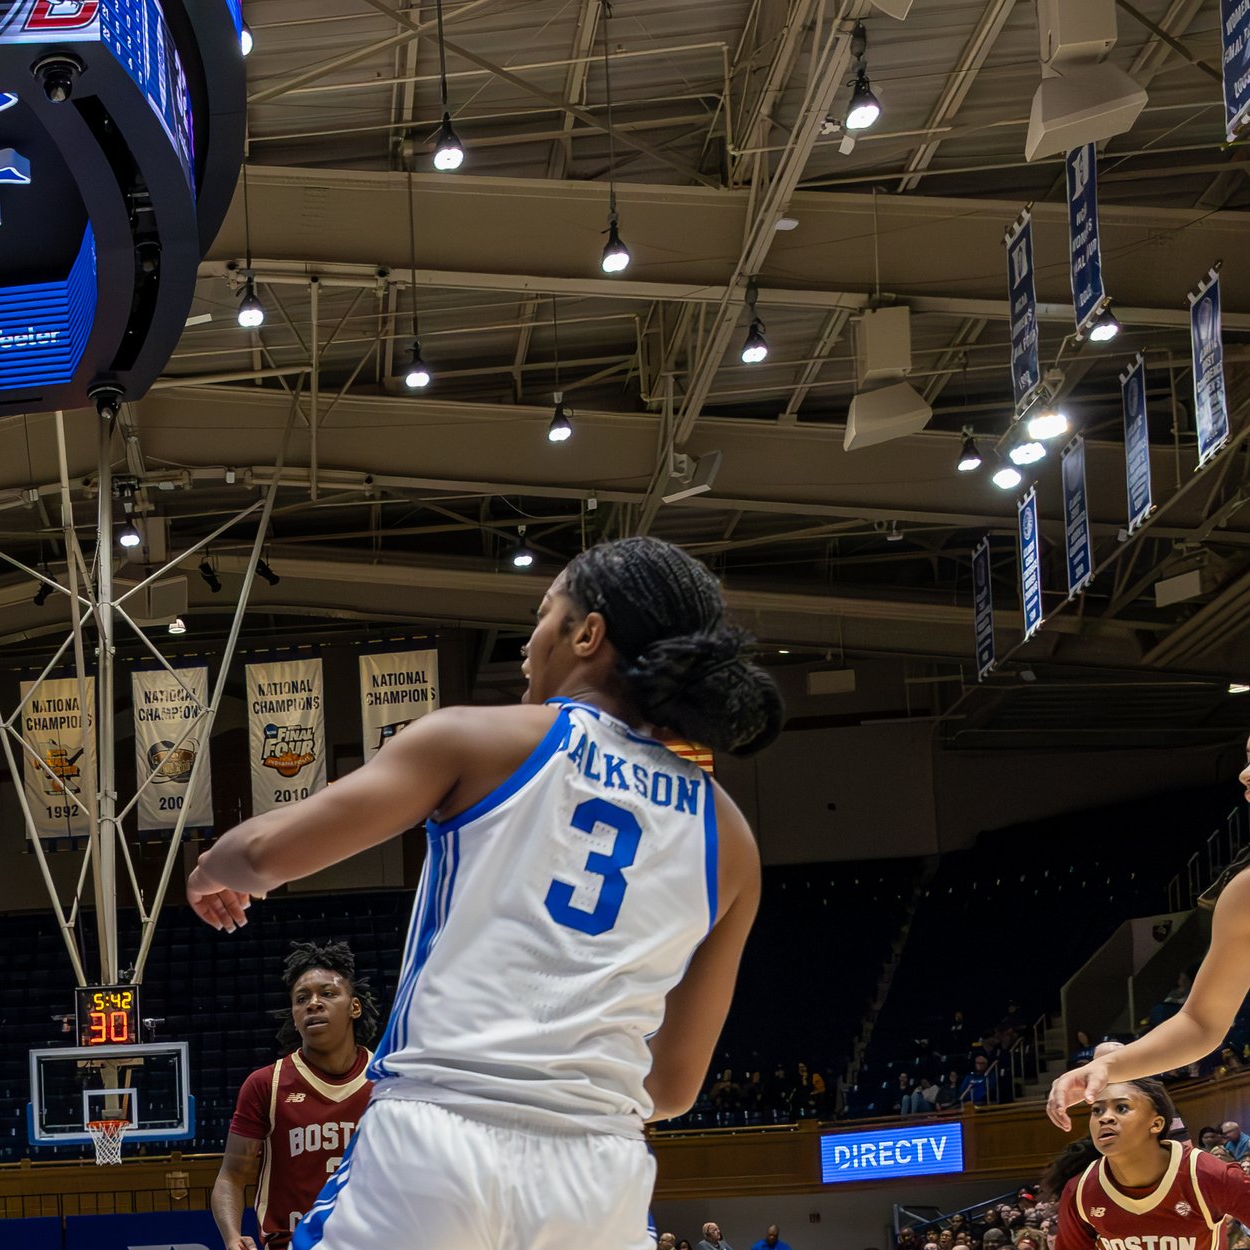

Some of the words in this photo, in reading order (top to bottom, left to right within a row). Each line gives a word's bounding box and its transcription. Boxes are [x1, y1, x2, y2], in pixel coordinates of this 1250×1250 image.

[258, 679, 312, 697] NATIONAL
[372, 671, 428, 688] NATIONAL
[366, 686, 436, 705] CHAMPIONS
[32, 698, 80, 714] NATIONA
[138, 705, 202, 722] CHAMPION
[253, 696, 320, 714] CHAMPIONS
[277, 727, 315, 741] FINAL
[262, 740, 316, 760] FOUR
[557, 724, 700, 815] JACKSON
[159, 796, 191, 811] 200
[274, 787, 309, 803] 2010
[46, 804, 79, 819] 1992
[544, 797, 643, 936] 3
[93, 992, 132, 1010] 5:42
[90, 1011, 128, 1043] 30
[289, 1121, 356, 1157] BOST
[834, 1136, 947, 1170] DIRECTV
